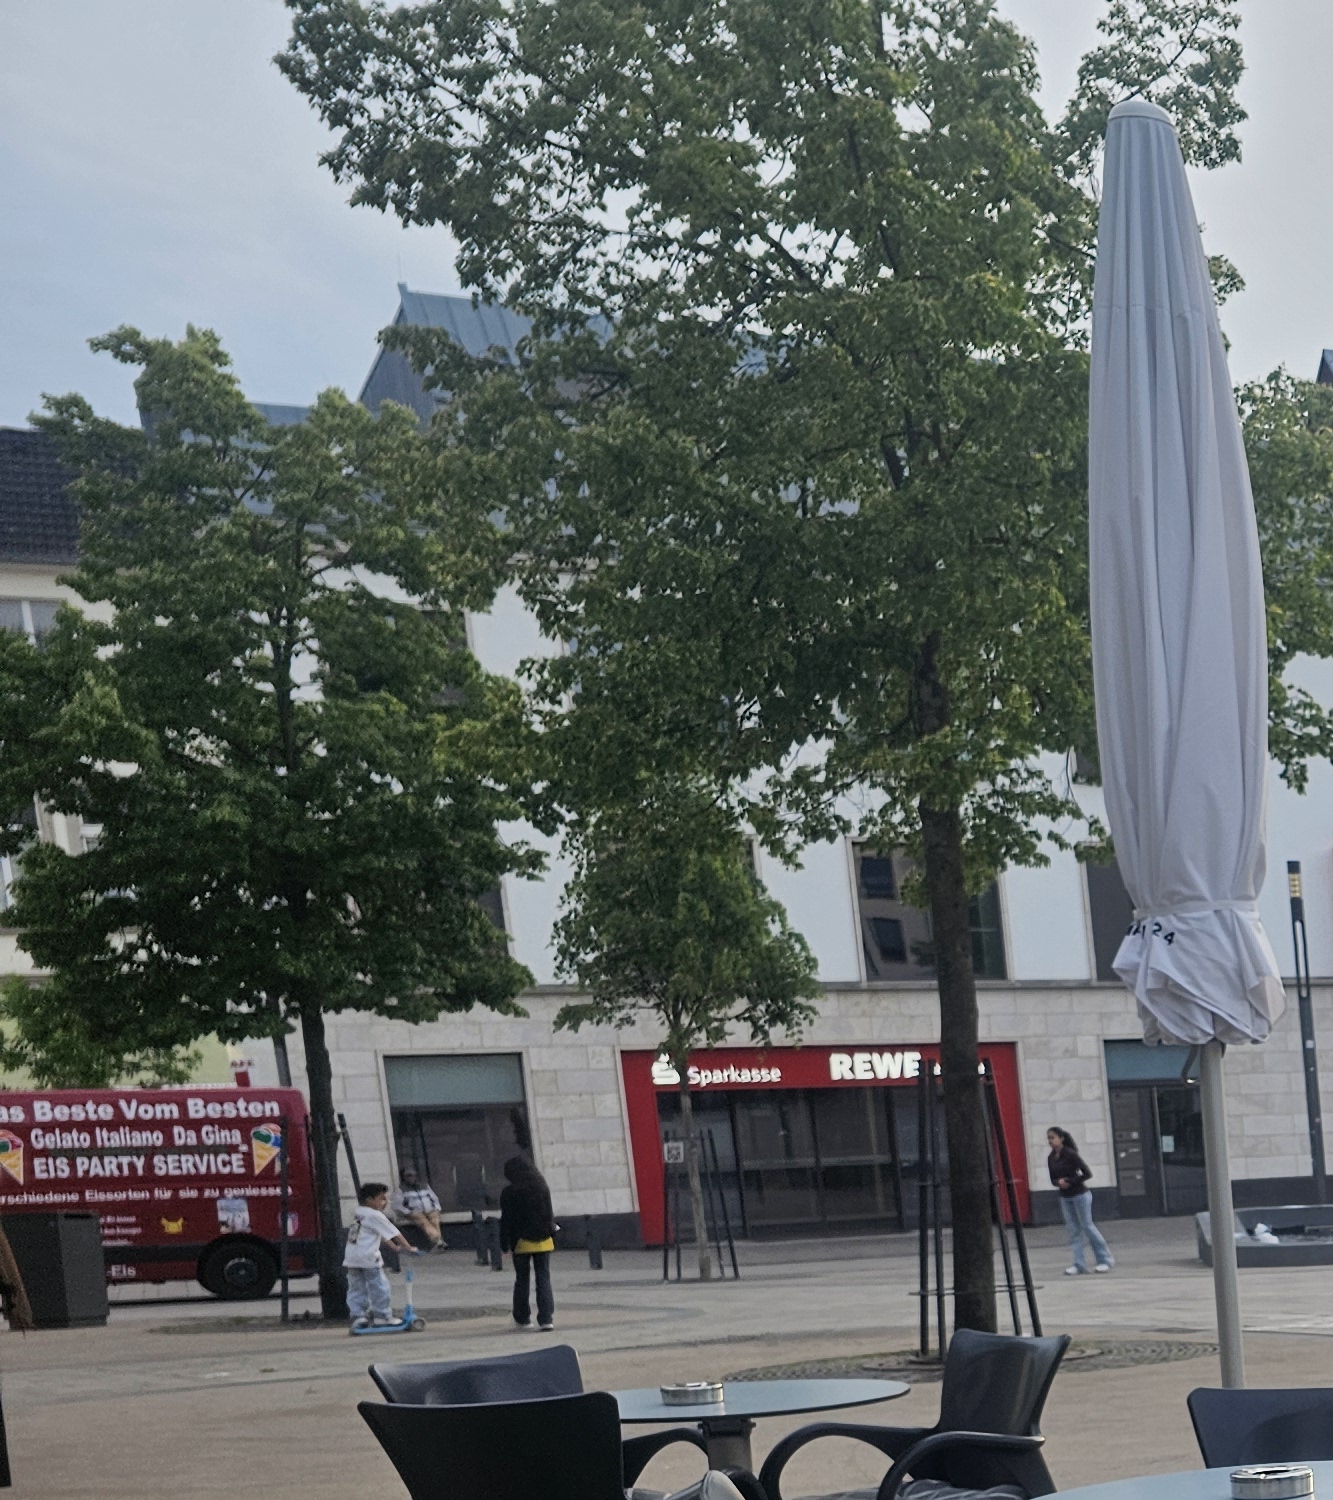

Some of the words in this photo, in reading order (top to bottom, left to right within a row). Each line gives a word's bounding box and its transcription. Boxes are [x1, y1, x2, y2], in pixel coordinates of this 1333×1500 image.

[687, 1063, 782, 1088] Sparkasse
[829, 1051, 922, 1081] REWE
[33, 1099, 115, 1122] Beste
[118, 1098, 179, 1120] Vom
[187, 1097, 280, 1119] Besten
[31, 1128, 91, 1149] Gelato
[95, 1125, 164, 1149] Italiano
[173, 1125, 198, 1147] Da
[201, 1123, 242, 1146] Gina
[34, 1156, 71, 1180] EIS
[75, 1155, 146, 1178] PARTY
[153, 1153, 246, 1177] SERVICE
[84, 1189, 150, 1202] Eissorten
[153, 1187, 173, 1200] für
[178, 1186, 199, 1199] sie
[203, 1187, 220, 1199] zu
